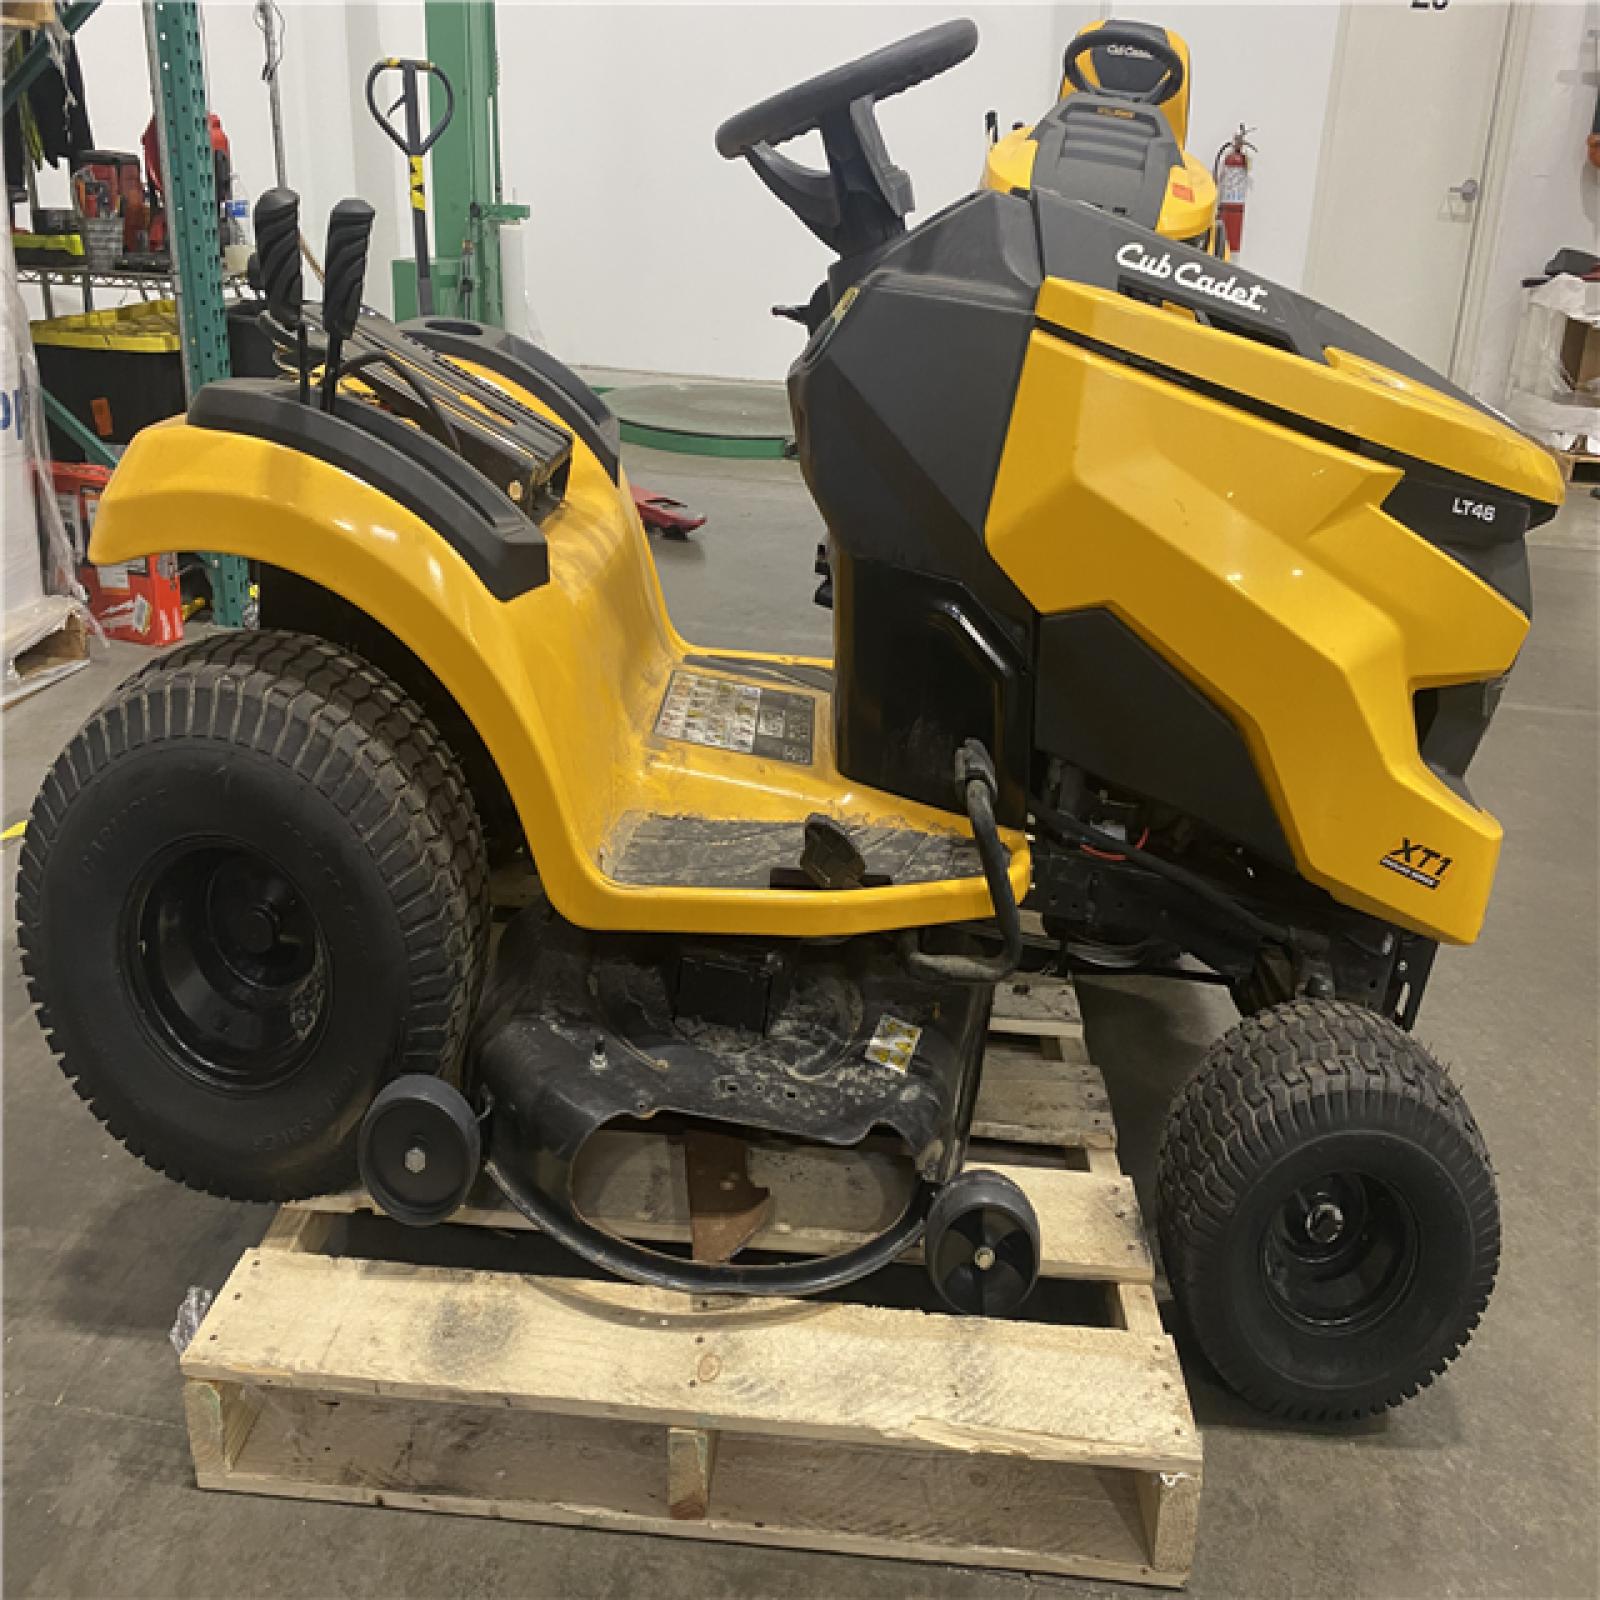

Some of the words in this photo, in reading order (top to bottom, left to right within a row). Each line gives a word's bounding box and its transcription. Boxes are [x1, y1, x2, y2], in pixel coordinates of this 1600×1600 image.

[1116, 243, 1171, 278] Cub
[1175, 263, 1268, 311] Cadet
[1389, 837, 1452, 876] XT1
